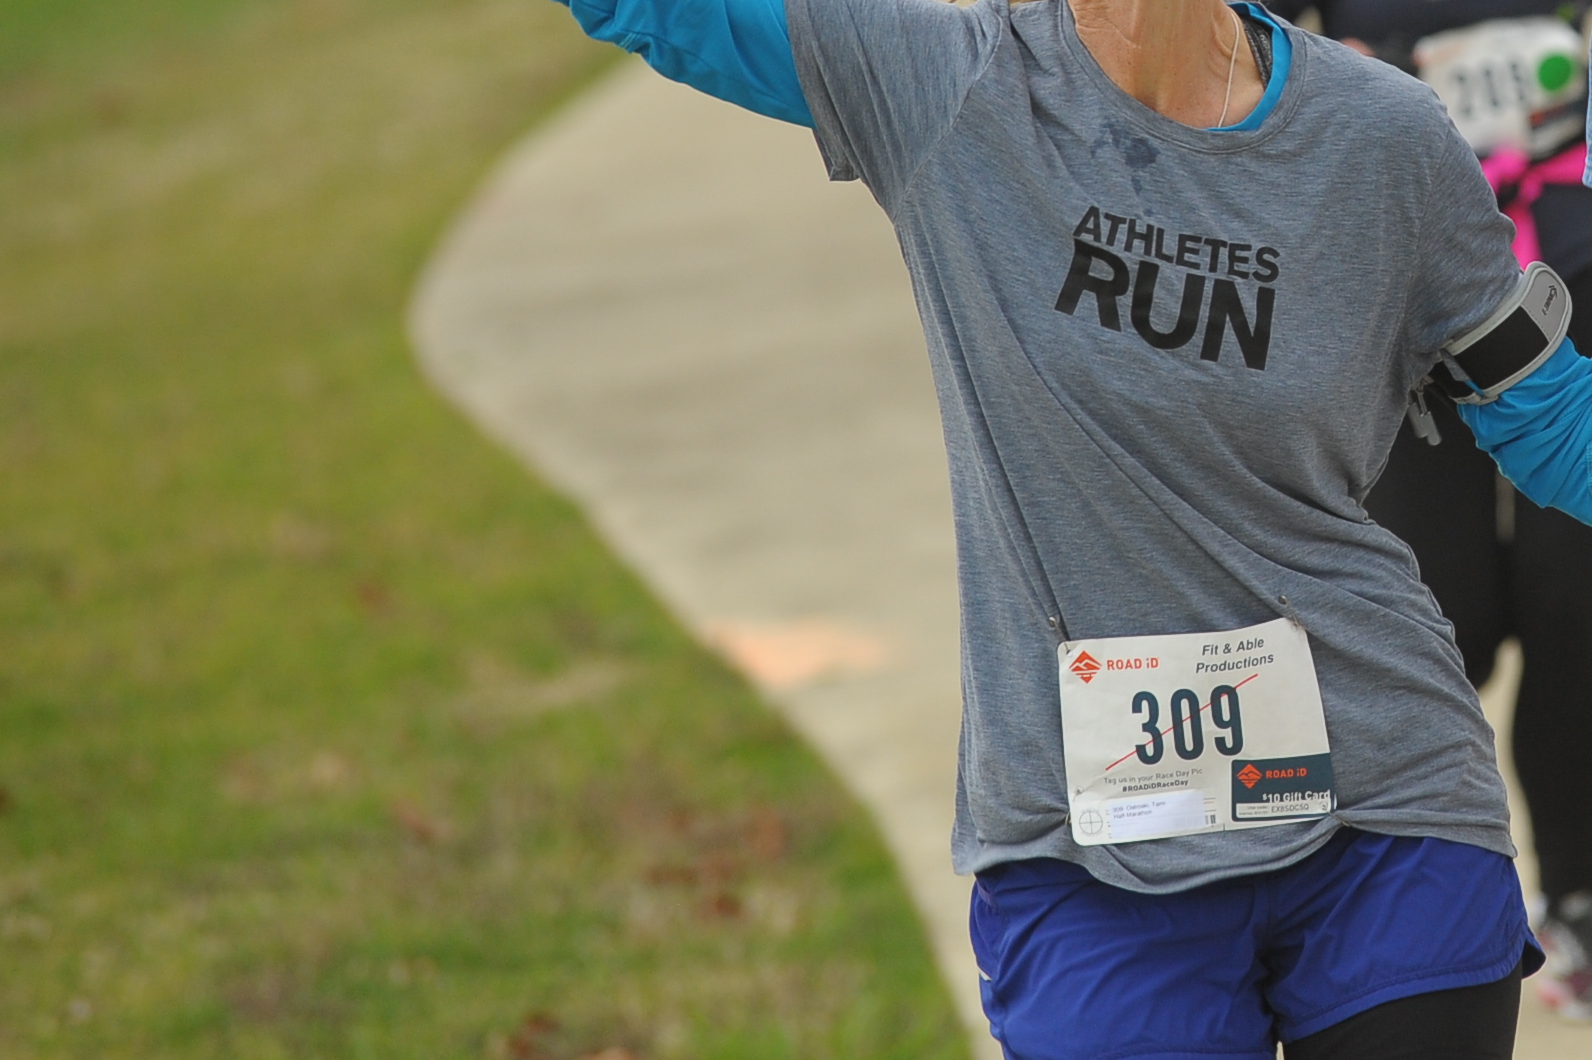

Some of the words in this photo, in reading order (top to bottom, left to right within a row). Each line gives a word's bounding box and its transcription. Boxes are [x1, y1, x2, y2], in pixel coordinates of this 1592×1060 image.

[1072, 205, 1281, 283] ATHLETES
[1054, 238, 1276, 371] RUN
[1202, 644, 1218, 656] Fit
[1222, 643, 1232, 654] &
[1236, 638, 1264, 652] Able
[1106, 658, 1142, 671] ROAD
[1196, 654, 1274, 673] Productions
[1131, 684, 1244, 765] 309
[1104, 777, 1116, 785] Tag
[1119, 776, 1127, 784] us
[1137, 775, 1153, 784] your
[1156, 771, 1174, 780] Race
[1176, 769, 1189, 779] Day
[1265, 768, 1294, 779] ROAD
[1262, 792, 1280, 803] $10
[1282, 791, 1303, 802] Gift
[1304, 788, 1331, 800] Card
